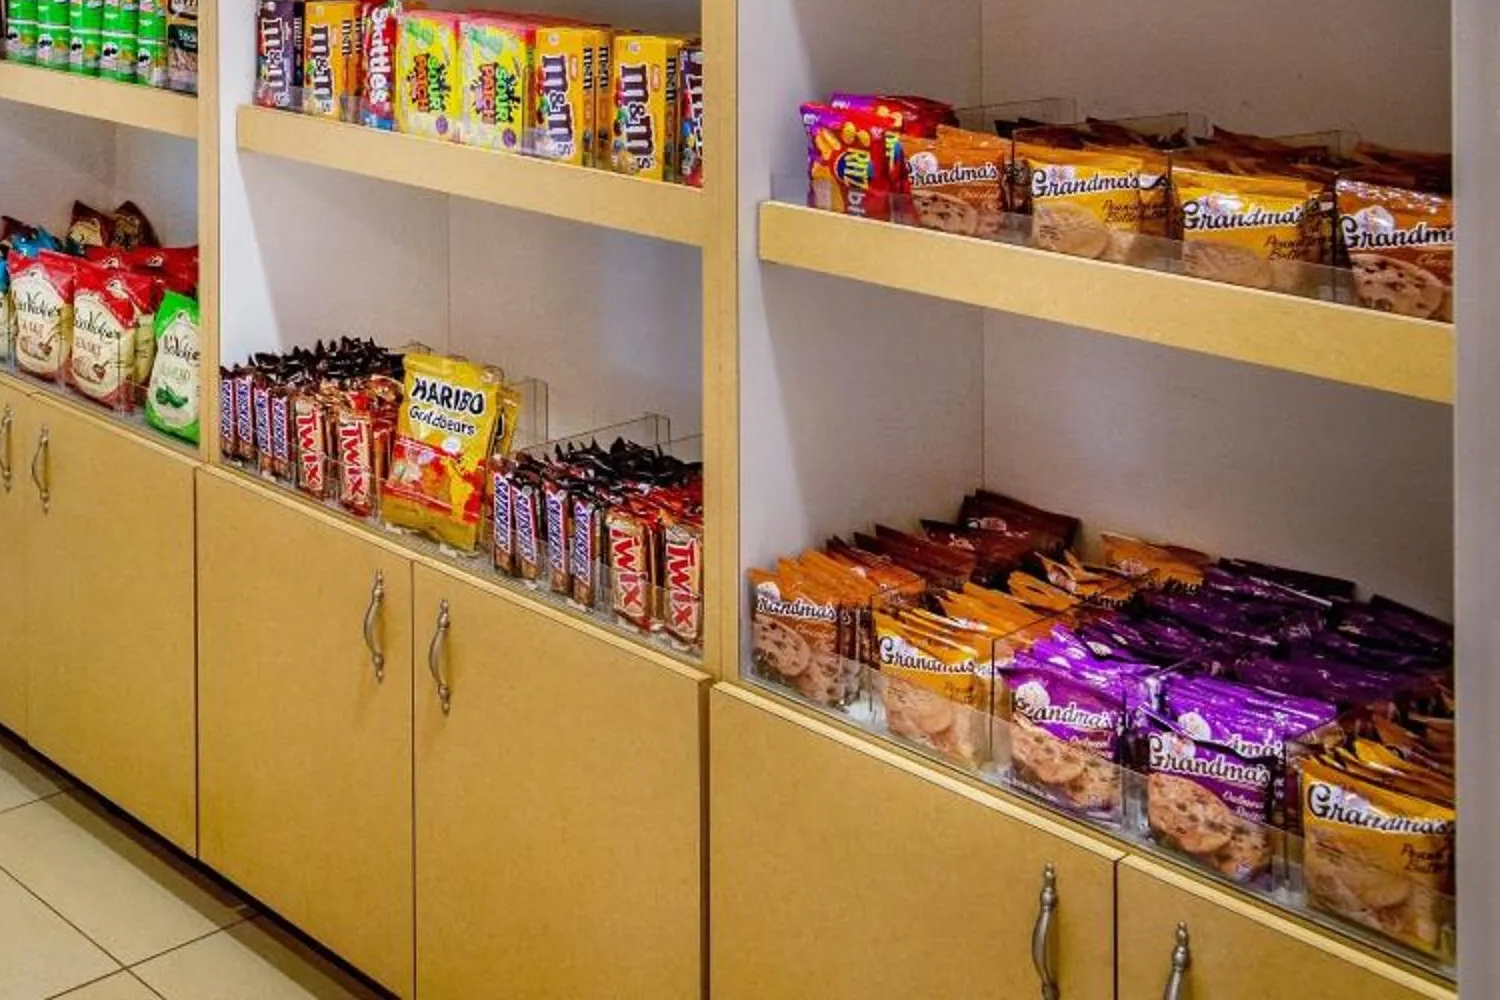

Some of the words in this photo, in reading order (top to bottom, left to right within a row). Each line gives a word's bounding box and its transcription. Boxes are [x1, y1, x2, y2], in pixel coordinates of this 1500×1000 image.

[368, 6, 392, 105] Skittles
[482, 63, 496, 124] PATCH
[495, 66, 509, 122] SOUR
[542, 55, 574, 155] m&m's
[621, 65, 653, 168] m&m's
[843, 149, 870, 190] RITZ
[1031, 169, 1140, 197] Grandma's
[1341, 215, 1453, 249] Grandm
[409, 405, 476, 436] Goldbears
[411, 377, 485, 416] HARIBO
[666, 539, 697, 629] TWIX
[1149, 735, 1271, 786] Grandma's
[1307, 783, 1447, 834] Grandma's
